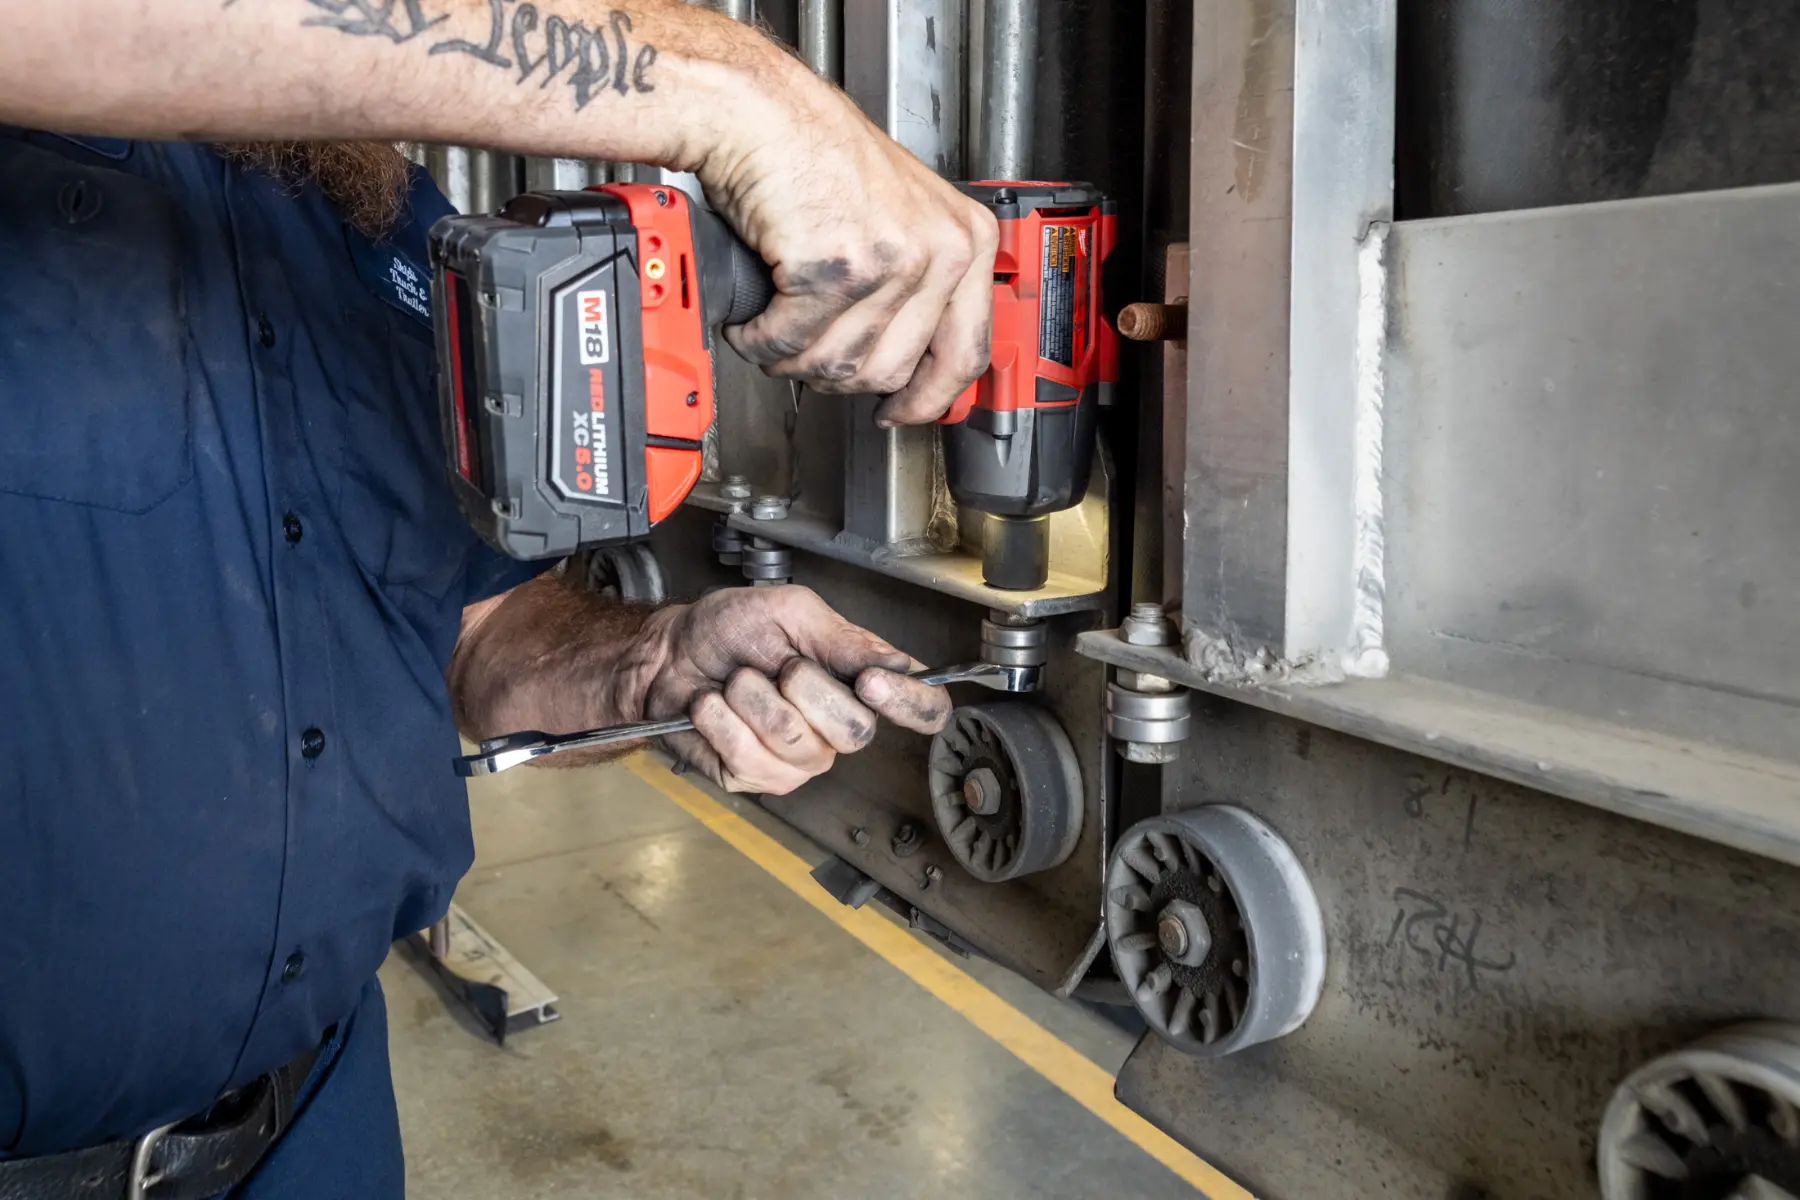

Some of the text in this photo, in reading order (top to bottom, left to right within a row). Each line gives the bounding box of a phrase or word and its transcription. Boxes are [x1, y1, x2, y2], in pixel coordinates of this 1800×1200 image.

[390, 268, 428, 301] Truck &
[396, 285, 430, 317] Trailer
[584, 296, 603, 358] M18
[573, 410, 593, 491] XC5.0
